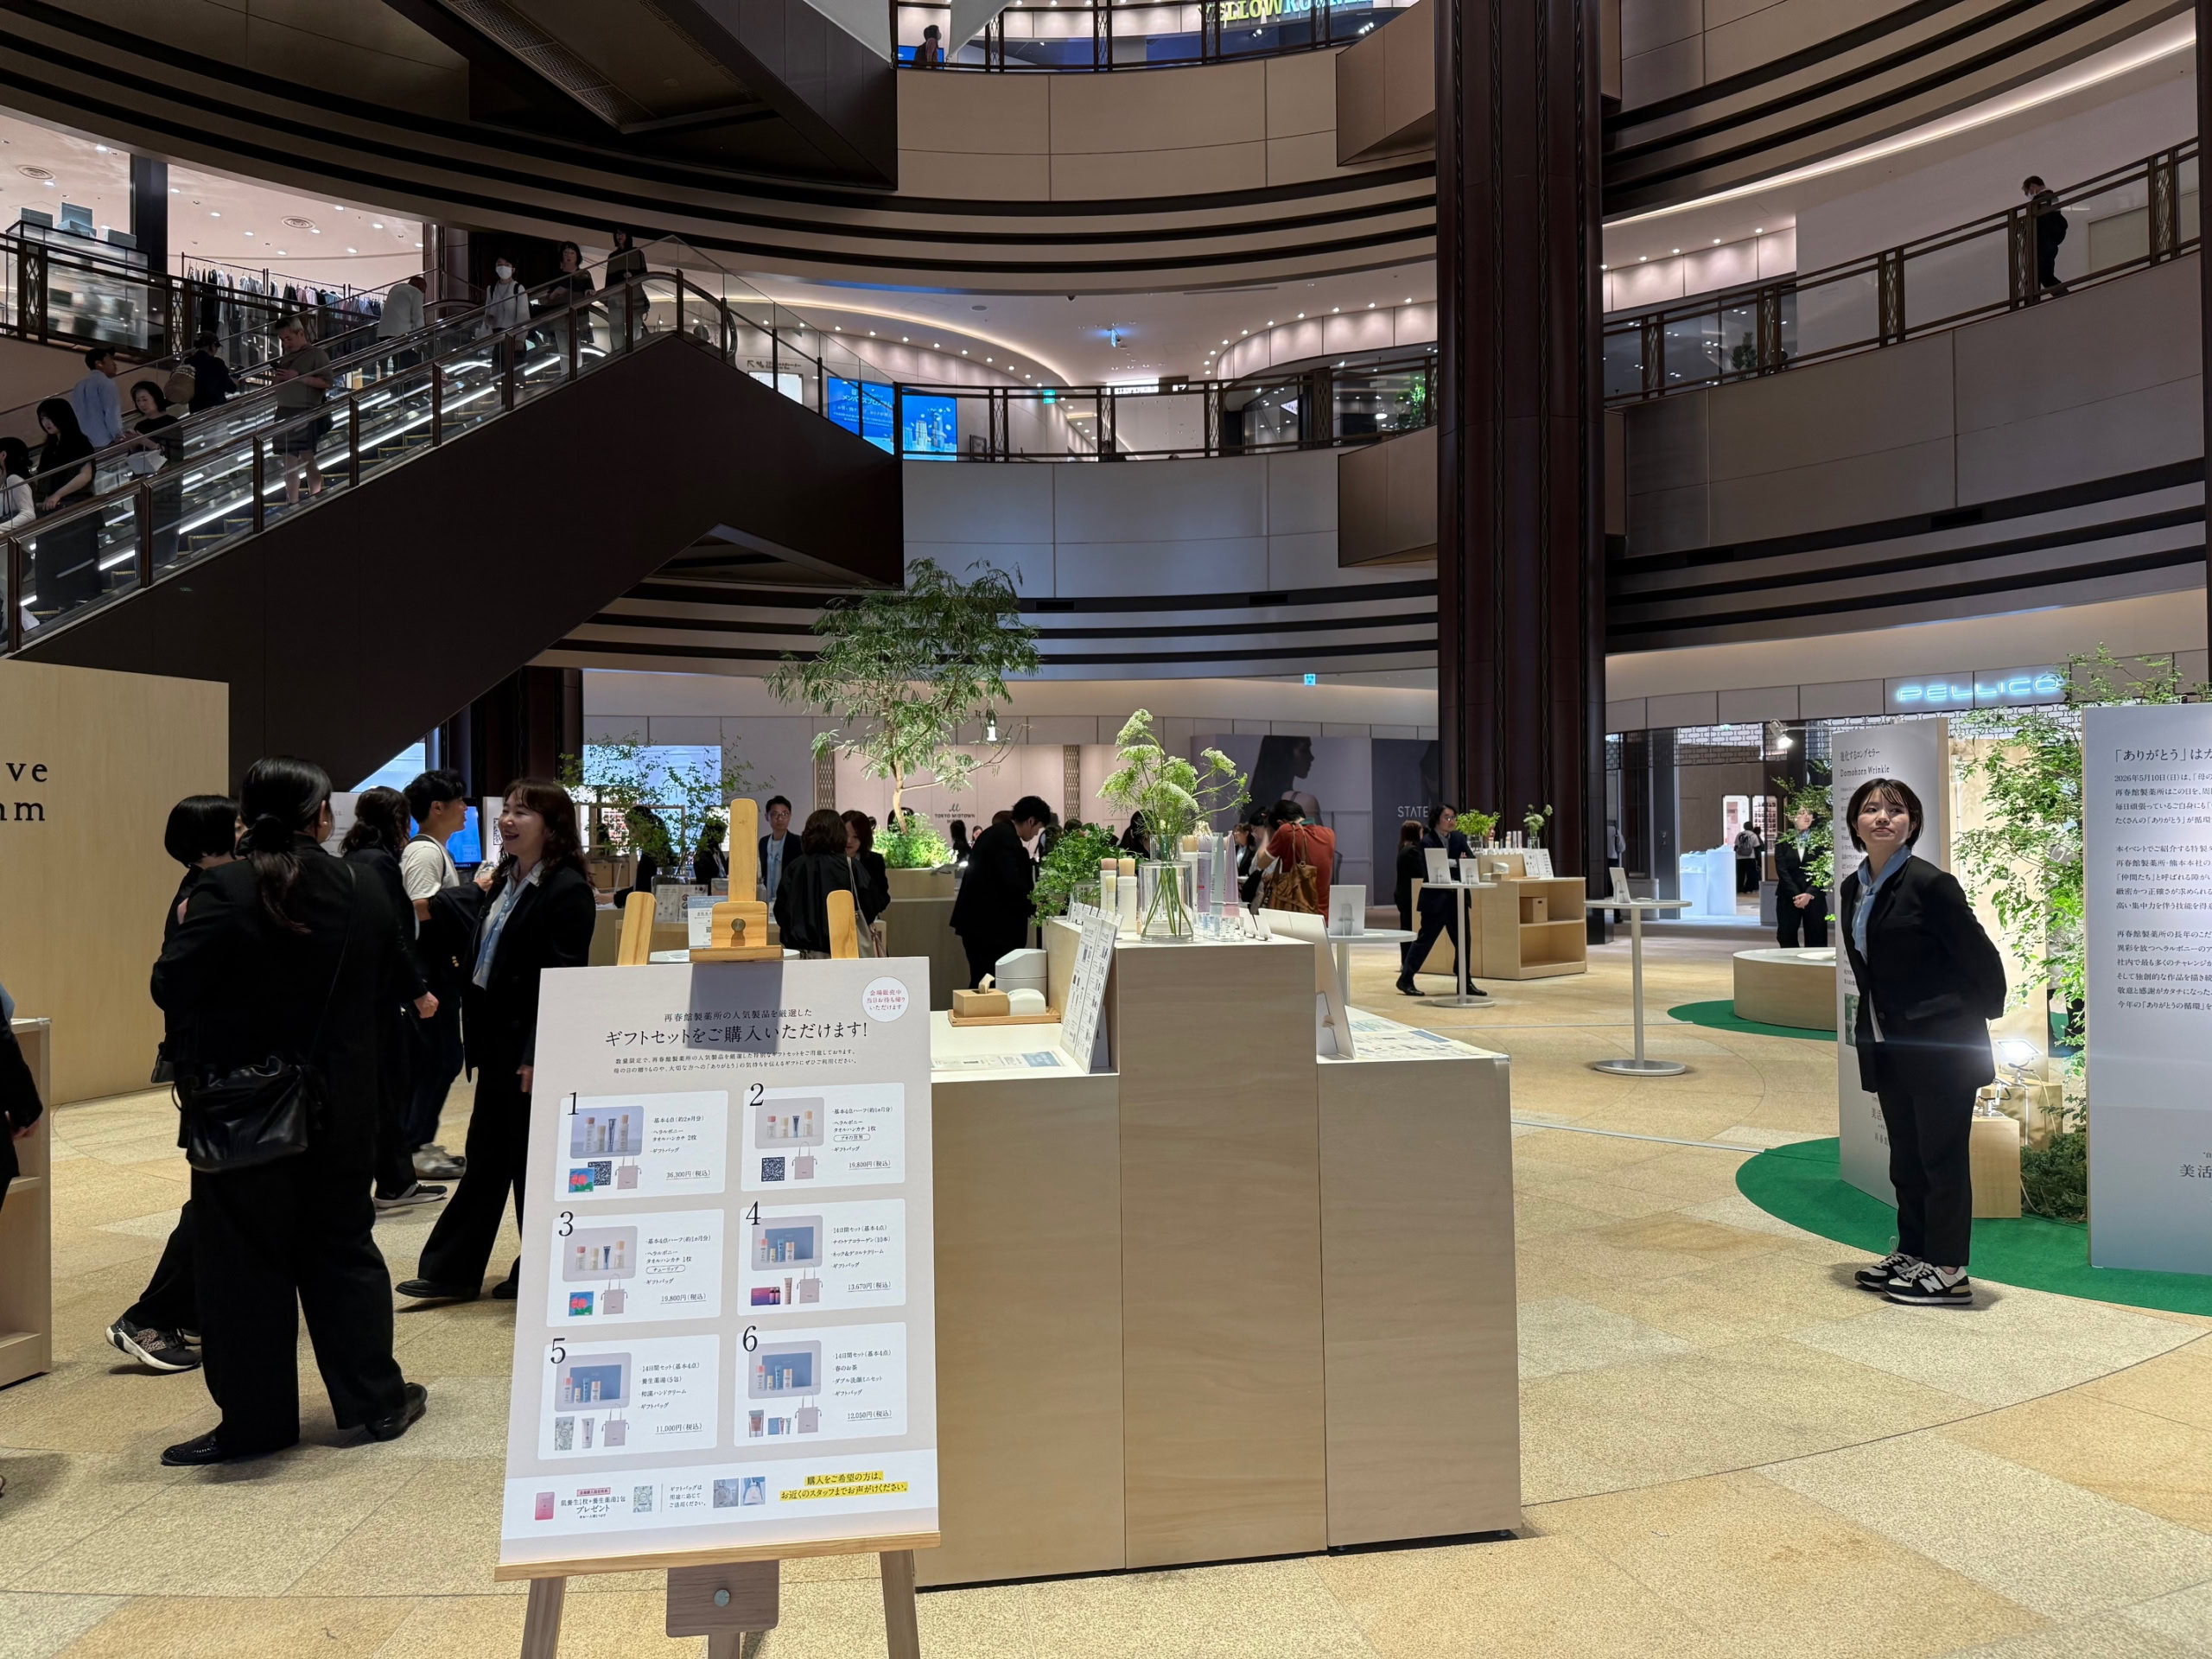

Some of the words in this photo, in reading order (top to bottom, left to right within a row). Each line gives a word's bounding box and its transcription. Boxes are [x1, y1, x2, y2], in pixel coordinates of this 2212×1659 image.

[1898, 677, 2060, 701] PELLICO
[1840, 767, 1866, 777] Domohorn
[1868, 765, 1890, 774] Wrinkle
[1397, 805, 1428, 817] STATE
[2115, 802, 2212, 810] 毎日頑張っているご自身にも「
[2115, 816, 2212, 824] たくさんの「ありがとう」が循環
[2117, 987, 2212, 995] 敬意と感謝がカタチになった
[568, 1092, 579, 1115] 1
[749, 1083, 764, 1107] 2
[746, 1201, 761, 1225] 4
[558, 1211, 574, 1236] 3
[742, 1325, 758, 1352] 6
[550, 1338, 566, 1364] 5
[807, 1471, 882, 1485] 購入をご希望の方は、
[780, 1482, 908, 1499] お近くのスタッフまでお声がけください。
[576, 1504, 610, 1514] プレゼント
